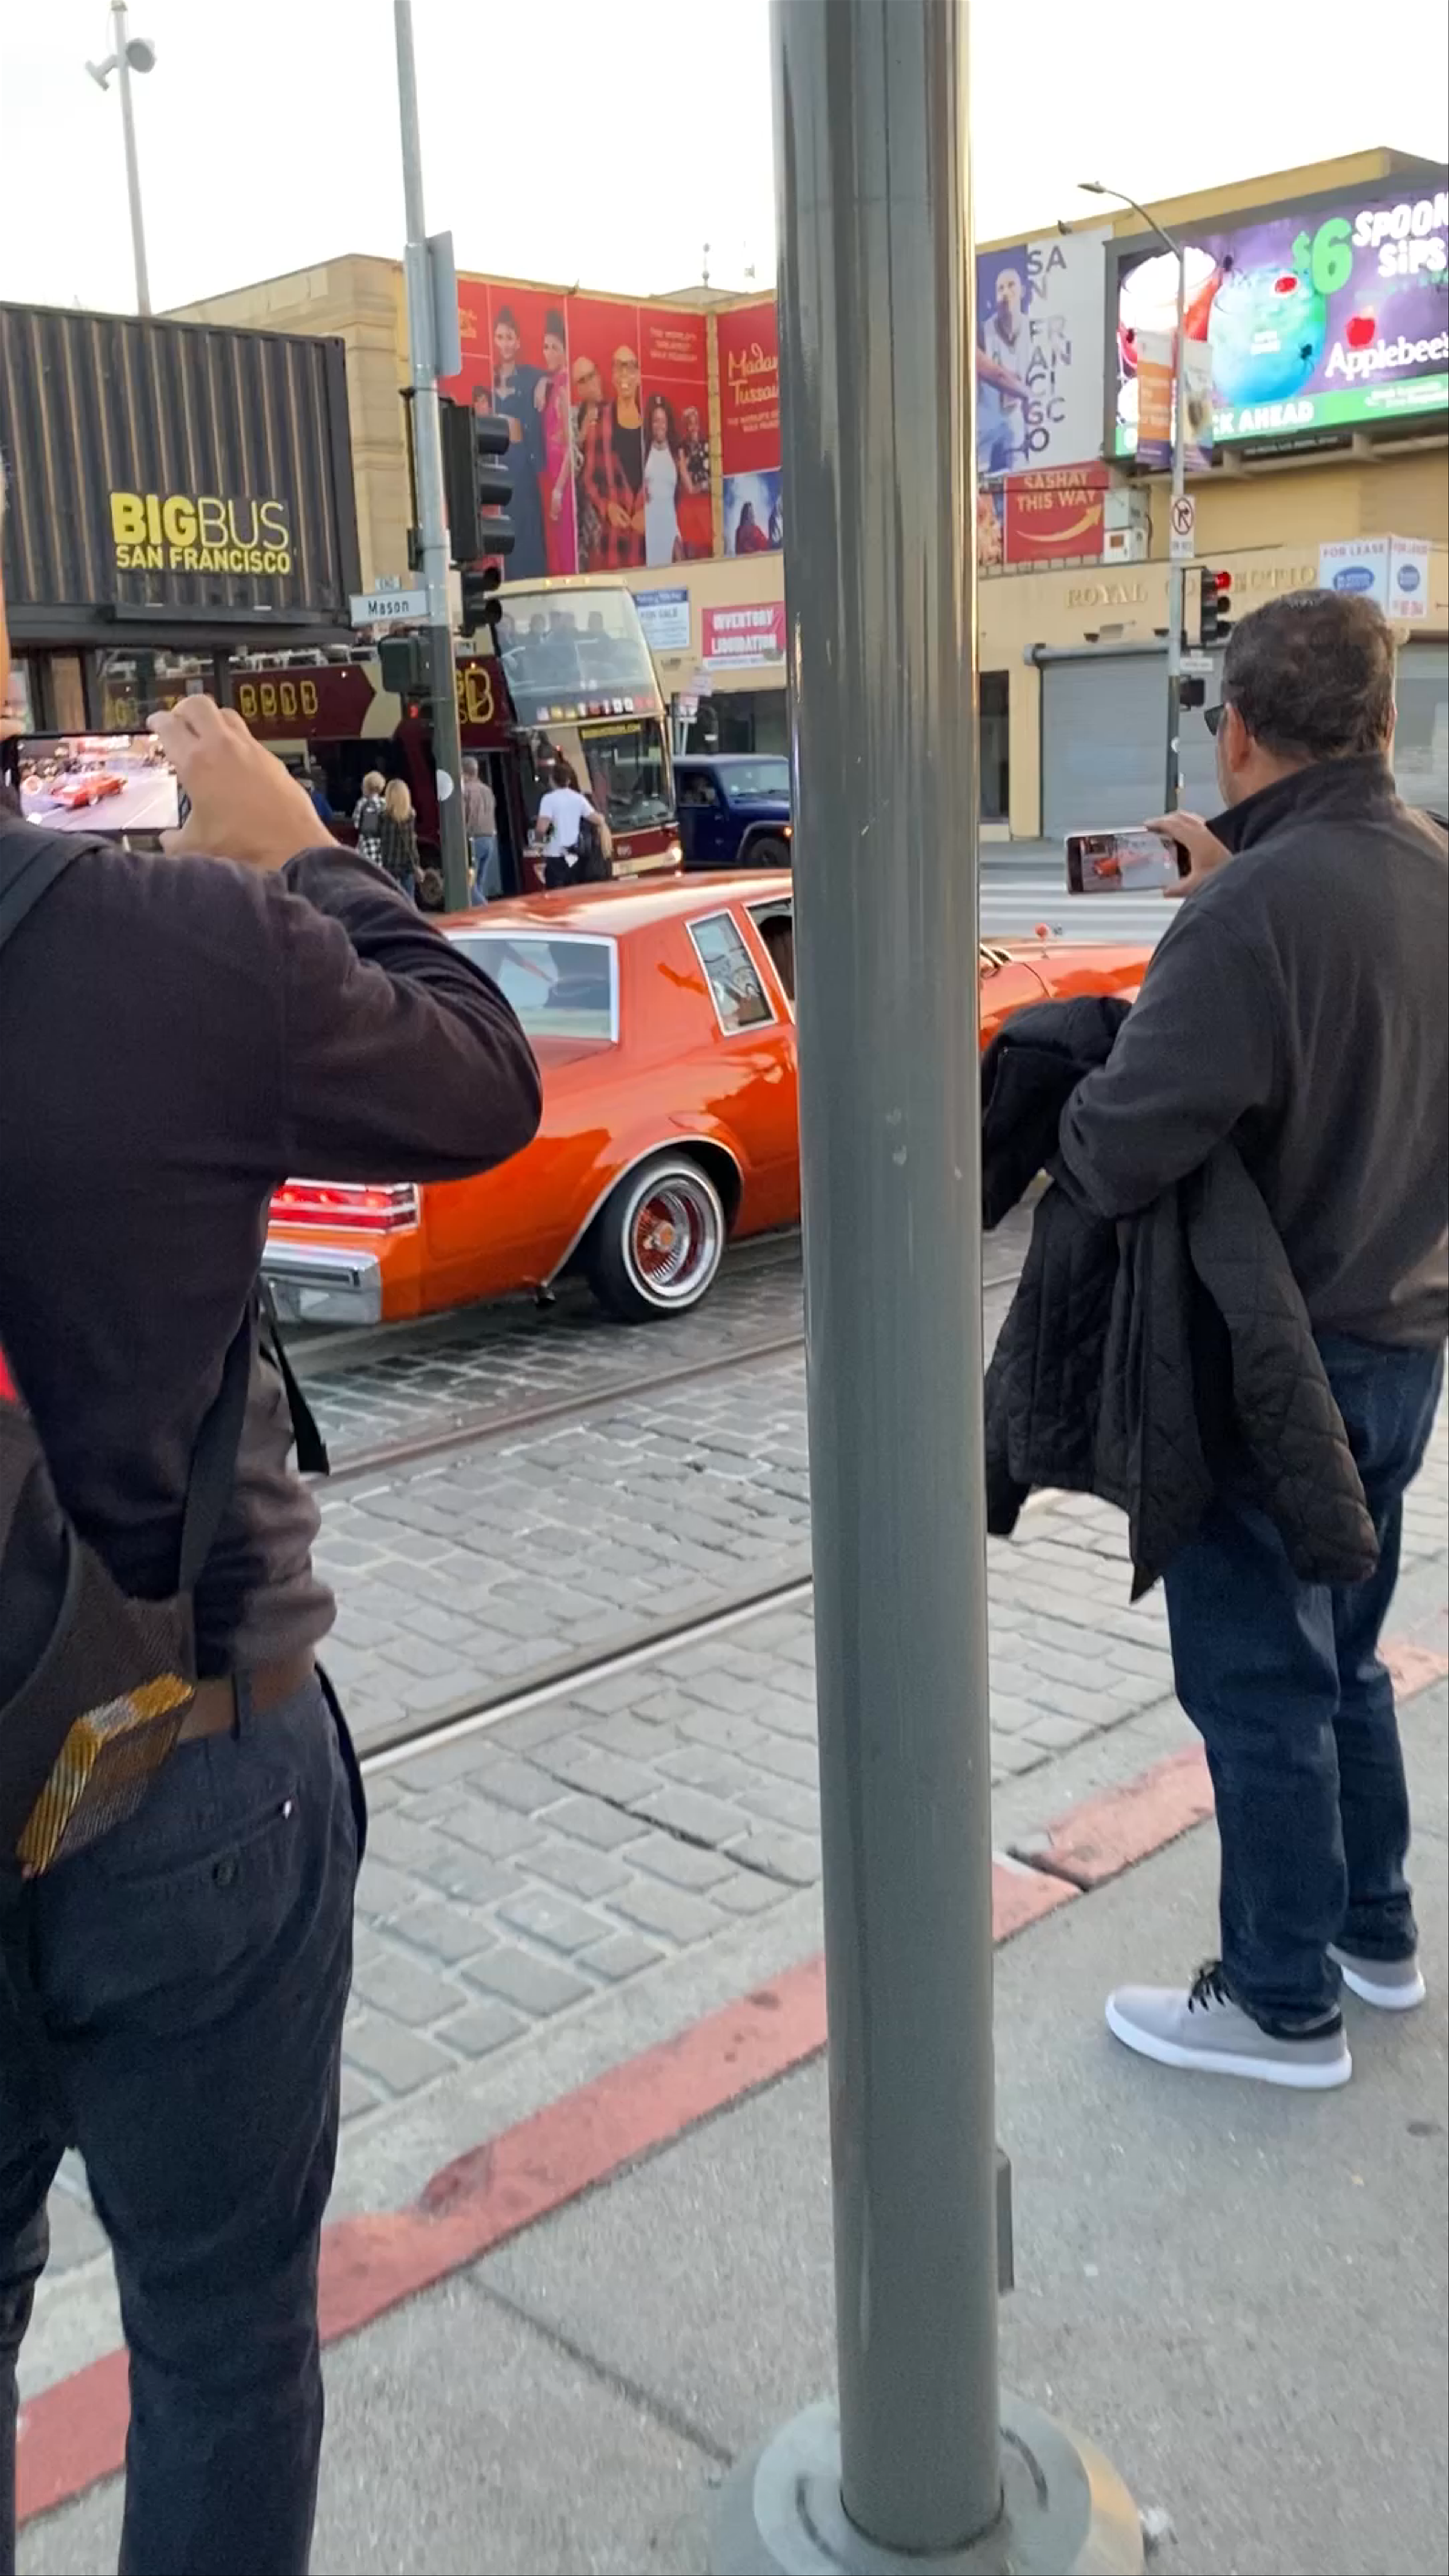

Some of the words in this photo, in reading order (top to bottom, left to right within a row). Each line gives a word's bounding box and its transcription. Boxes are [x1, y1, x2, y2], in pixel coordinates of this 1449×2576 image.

[728, 371, 779, 407] Tussau
[1239, 401, 1314, 432] AHEAD
[1024, 472, 1088, 490] SASHAY
[1018, 491, 1053, 512] THIS
[1058, 489, 1096, 508] WAY
[116, 545, 163, 569] SAN
[169, 547, 290, 574] FRANCISCO
[368, 600, 409, 616] Mason
